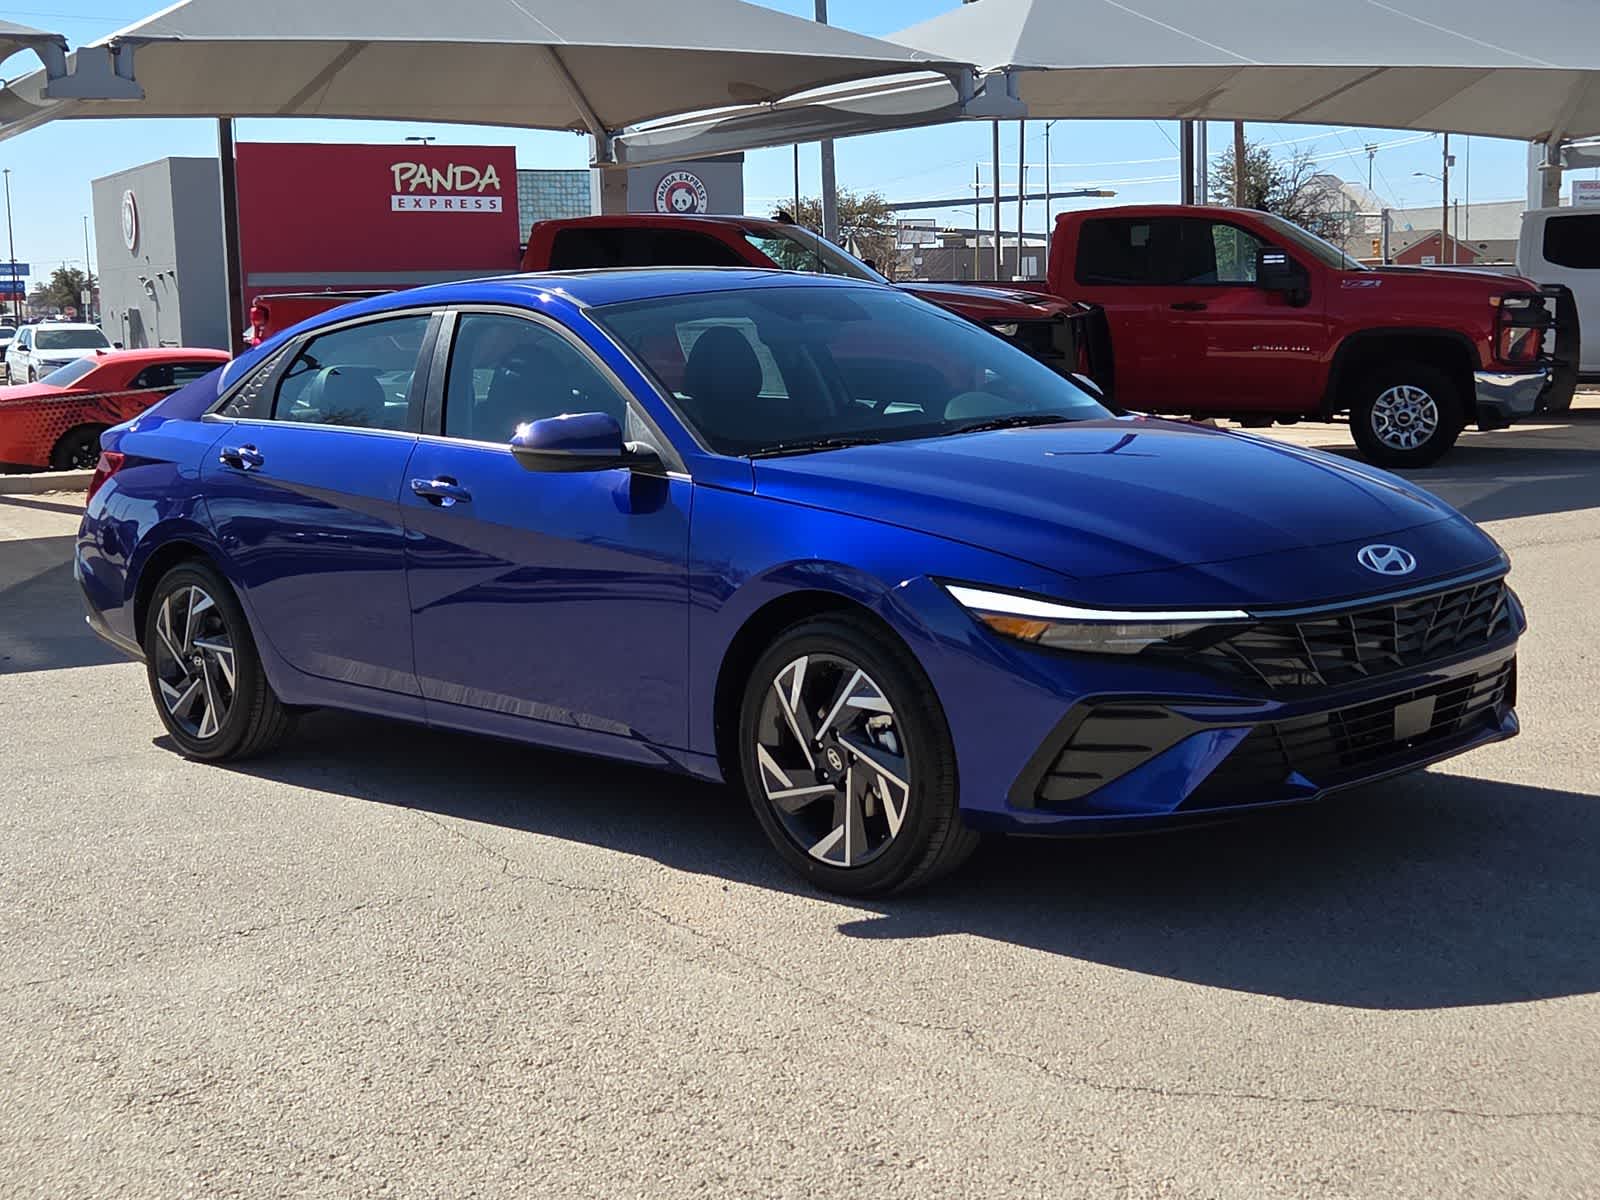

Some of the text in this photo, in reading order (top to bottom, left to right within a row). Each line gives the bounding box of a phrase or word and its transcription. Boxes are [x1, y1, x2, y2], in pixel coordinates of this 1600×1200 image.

[390, 162, 500, 193] PANDA
[658, 173, 706, 202] PANDA EXPRESS
[397, 198, 497, 209] EXPRESS
